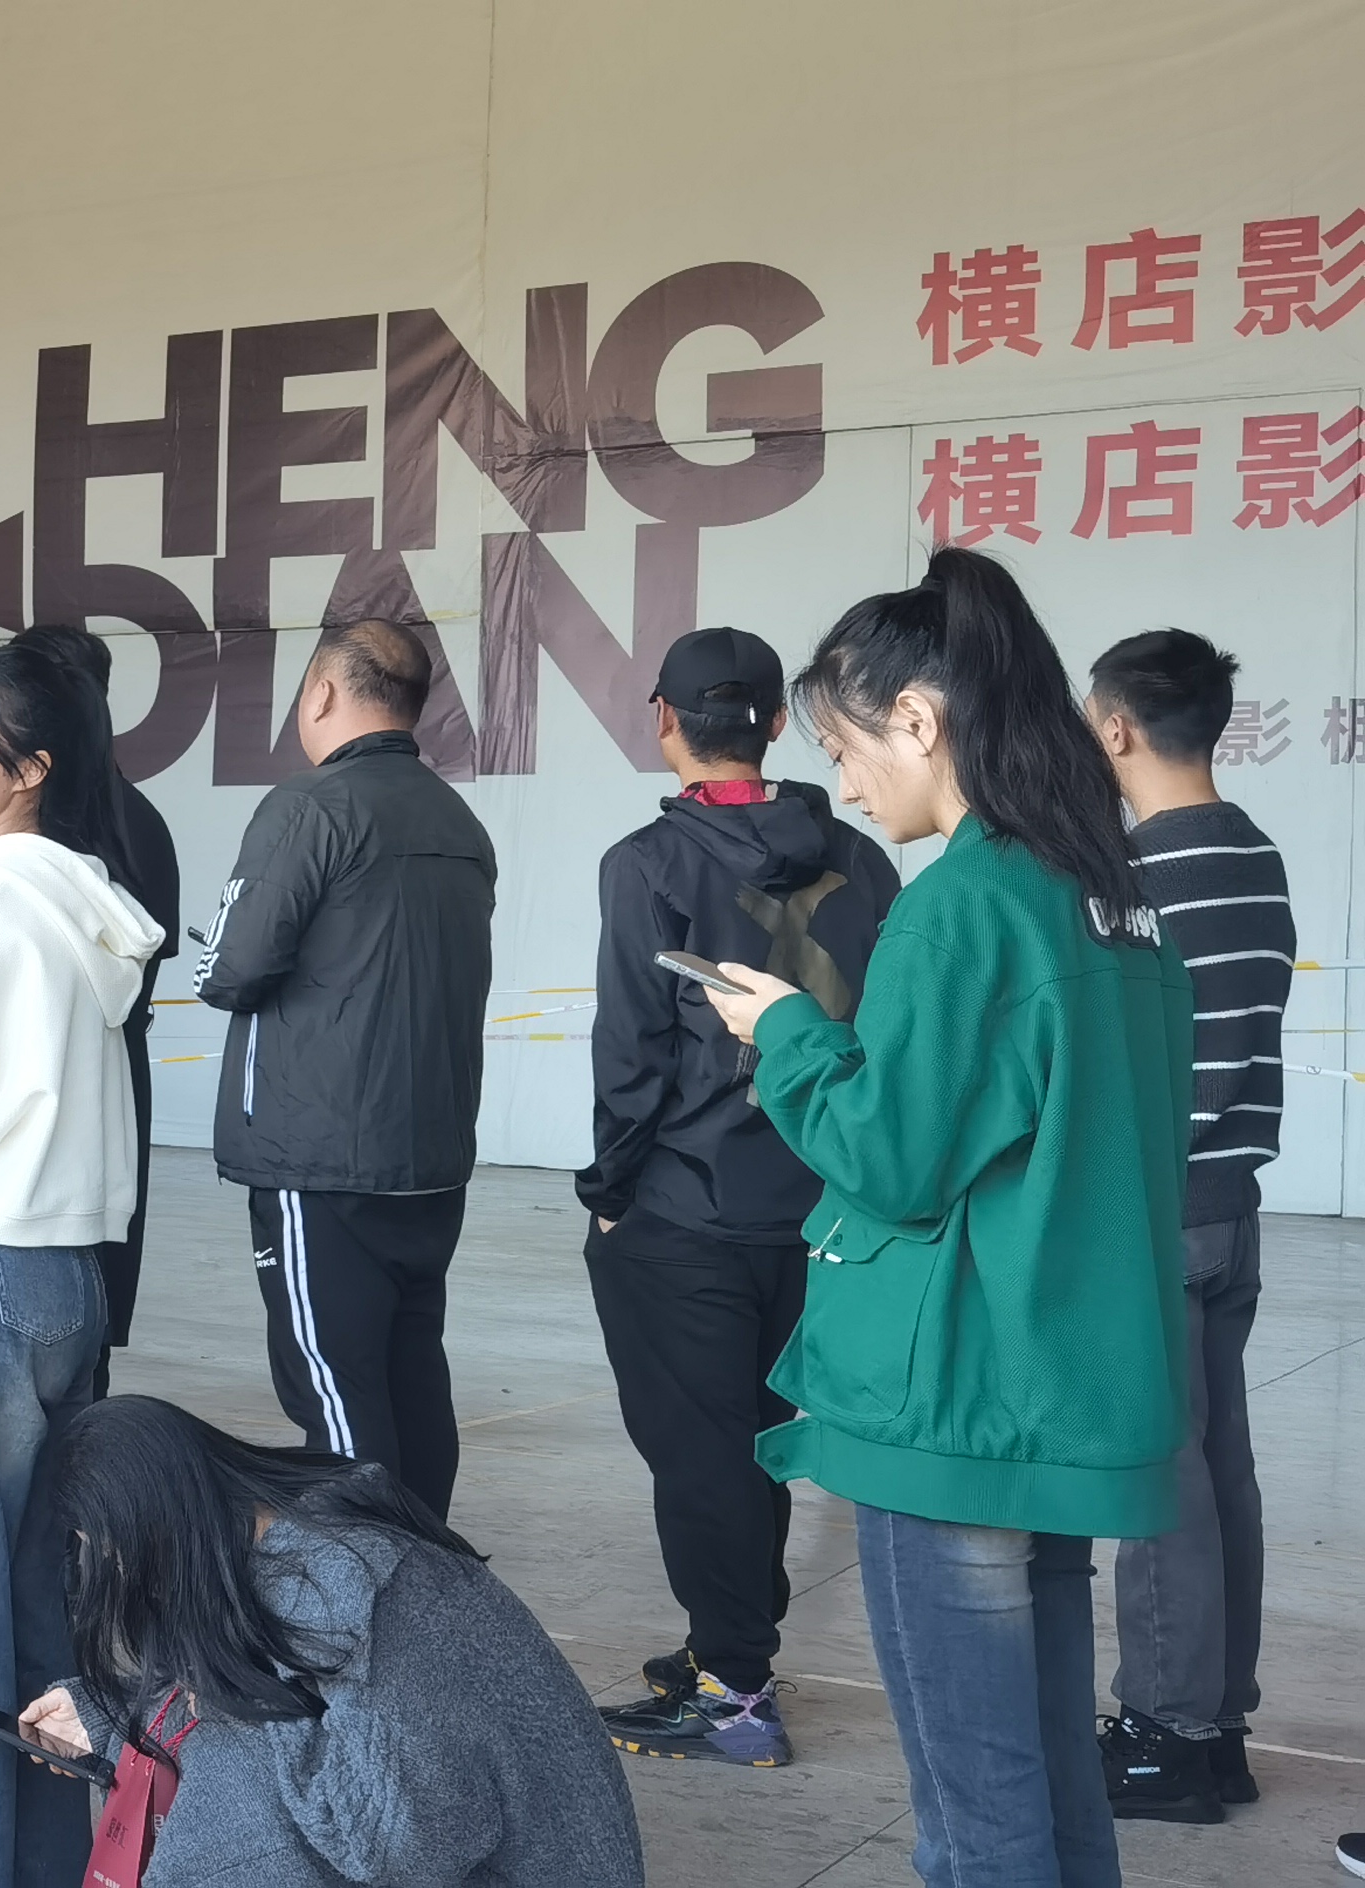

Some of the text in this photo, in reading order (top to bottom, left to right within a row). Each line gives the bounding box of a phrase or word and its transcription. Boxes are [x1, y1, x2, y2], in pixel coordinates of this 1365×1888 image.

[915, 207, 1365, 366] 横店影
[33, 261, 825, 560] HENG
[916, 405, 1365, 550] 横店影
[33, 522, 700, 788] DIAN
